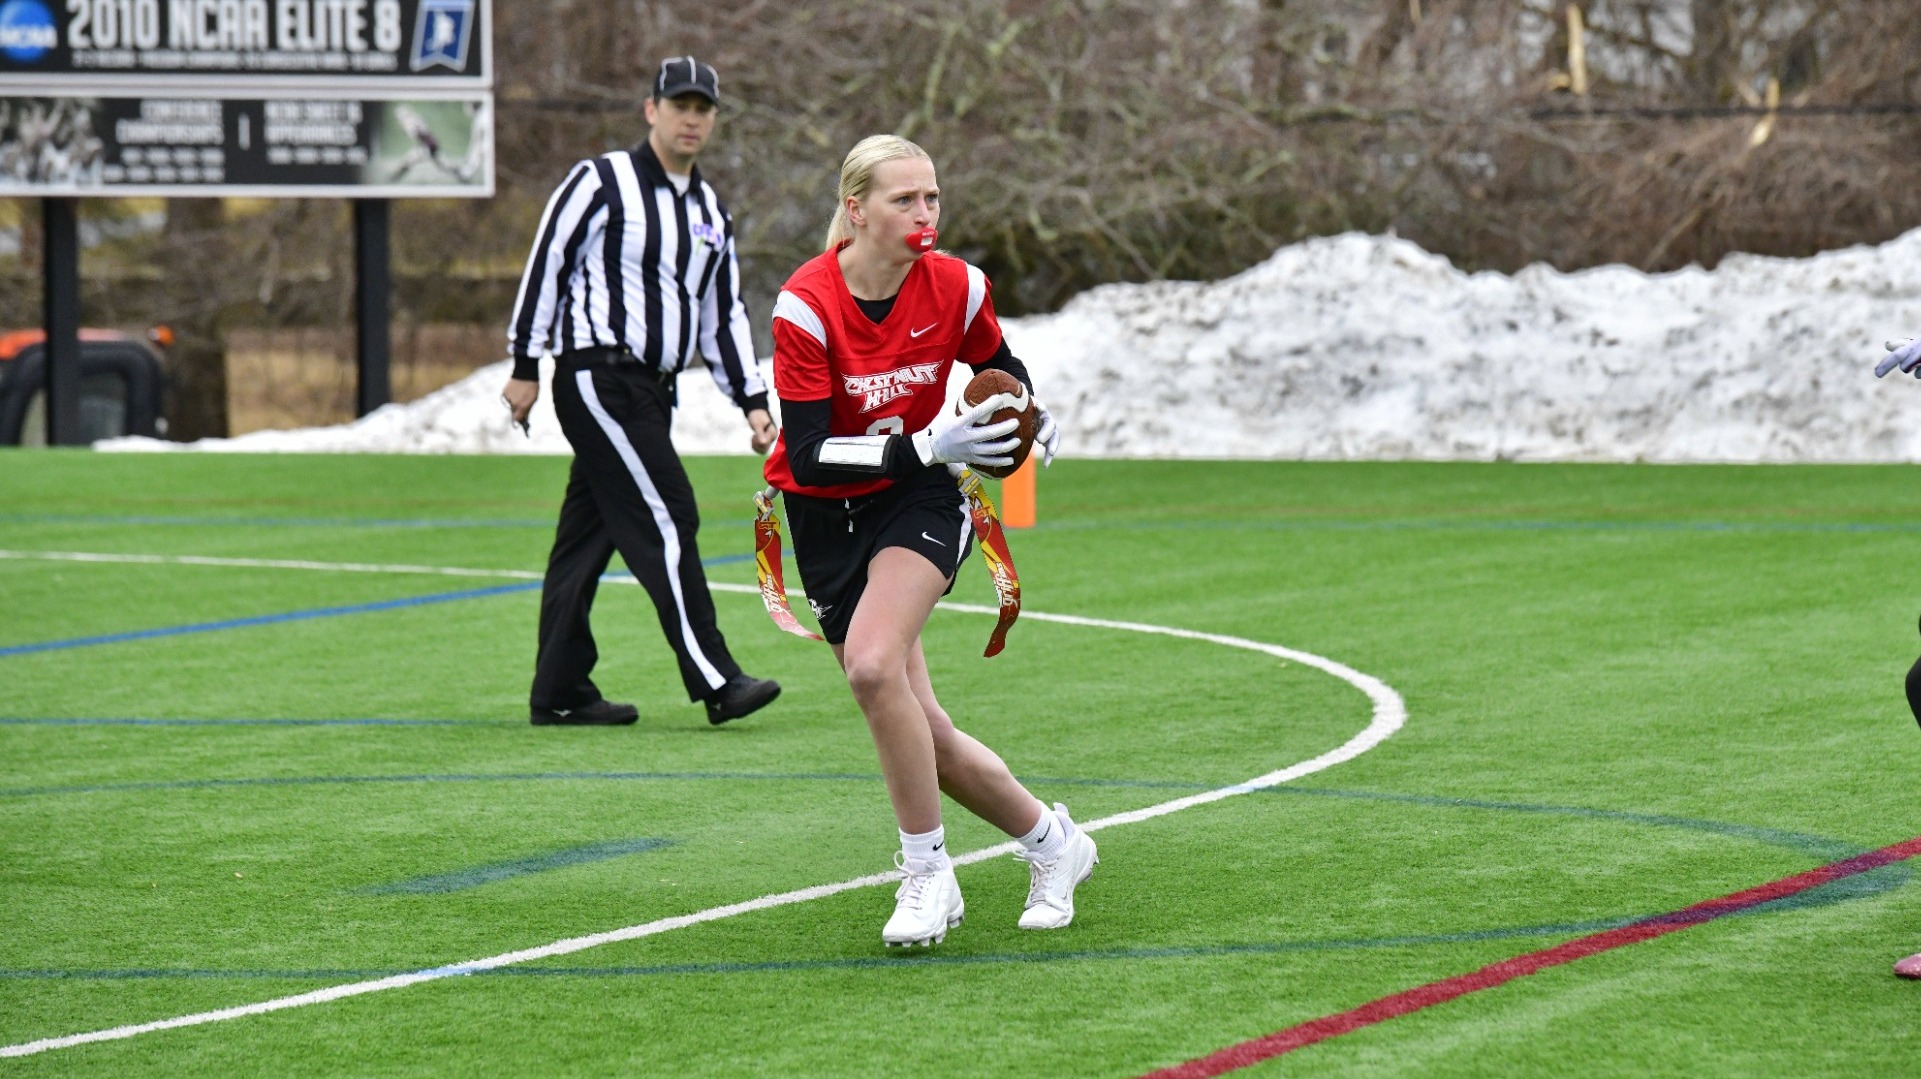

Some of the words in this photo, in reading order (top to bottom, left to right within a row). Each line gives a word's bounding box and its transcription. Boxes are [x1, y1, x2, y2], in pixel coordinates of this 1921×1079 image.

[66, 0, 160, 50] 2010
[167, 0, 268, 50] NCAA
[275, 0, 368, 51] ELITE
[373, 0, 402, 51] 8
[842, 361, 943, 396] CHESTNUT
[859, 384, 913, 413] HILL
